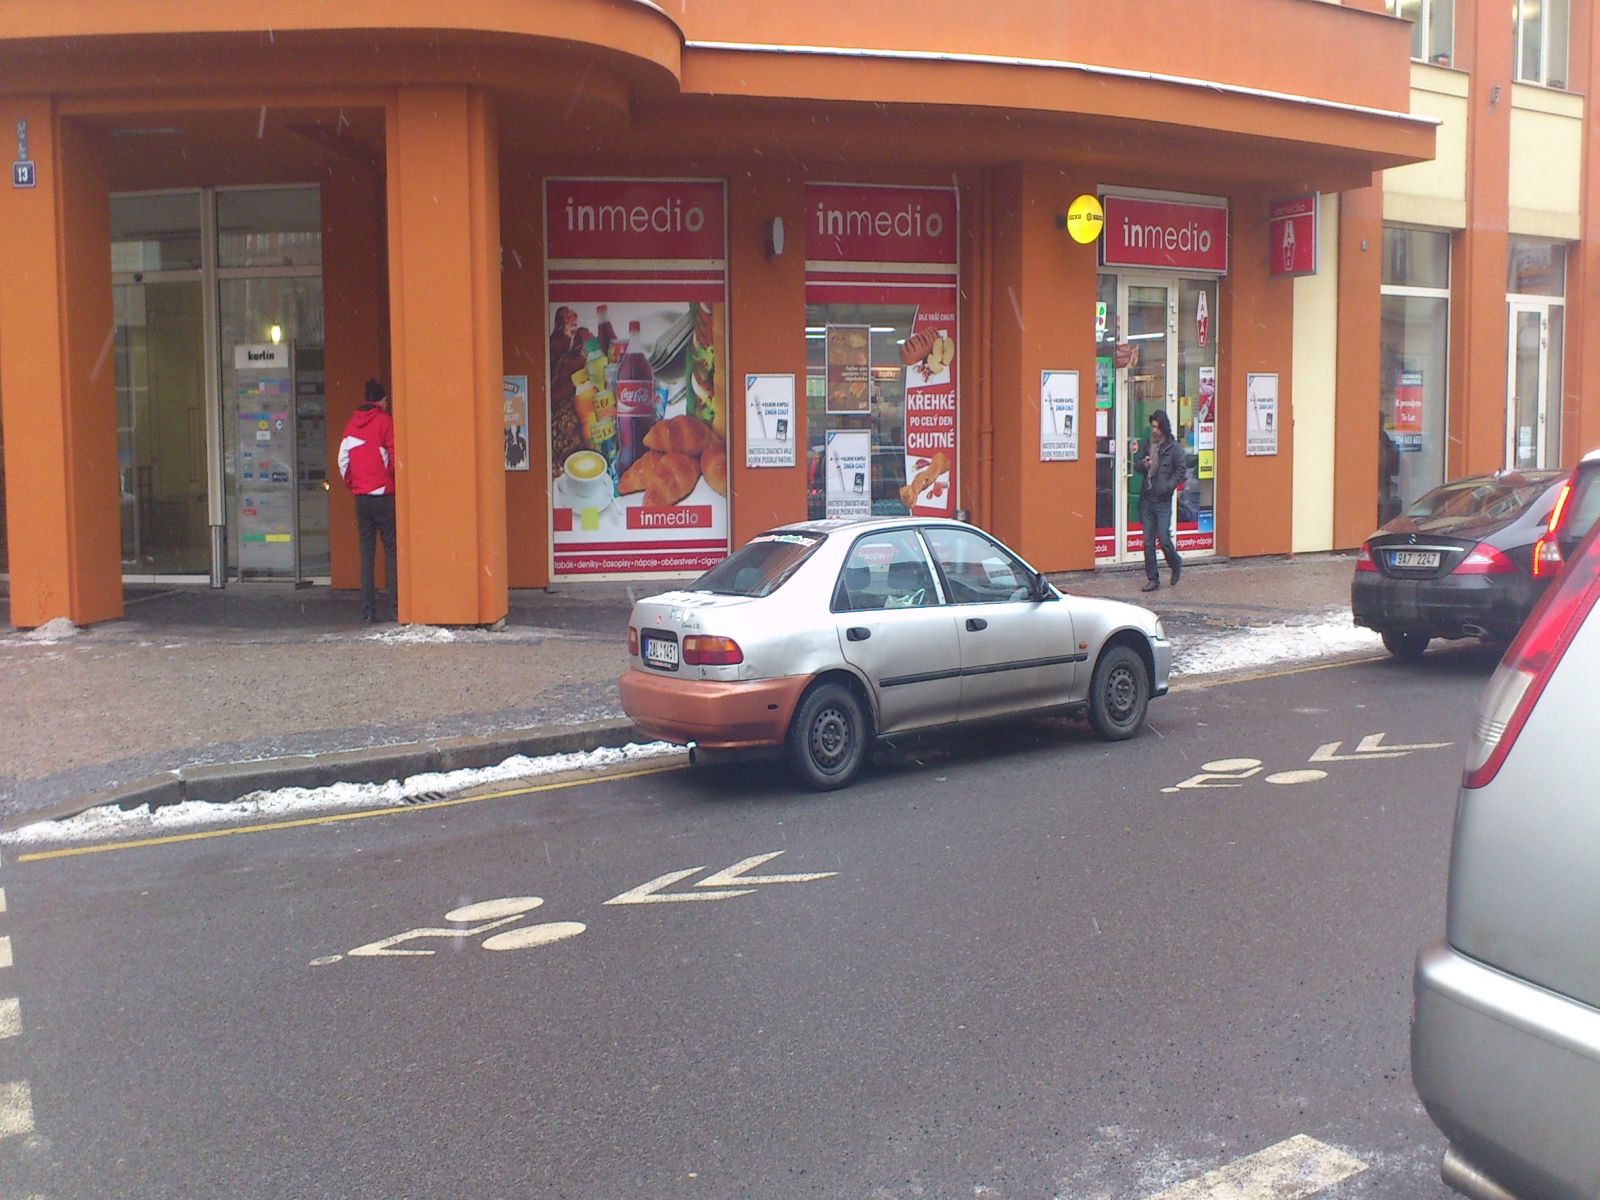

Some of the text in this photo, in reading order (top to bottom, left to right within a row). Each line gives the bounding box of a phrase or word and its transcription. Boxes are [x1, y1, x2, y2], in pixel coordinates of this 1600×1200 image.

[18, 167, 28, 182] 13
[566, 197, 704, 232] inmedio
[816, 202, 944, 237] inmedio
[1123, 216, 1211, 252] inmedio
[907, 389, 956, 411] KŘEHKÉ
[910, 414, 953, 427] PO CELÝ DEN
[908, 429, 955, 449] CHUTNÉ
[640, 510, 698, 525] inmedio
[555, 560, 574, 569] tabák
[577, 559, 599, 570] deníky
[602, 558, 631, 570] časopisy
[634, 557, 657, 569] nápoje
[661, 556, 698, 567] občerstvení
[1398, 553, 1437, 566] 9A7 2247
